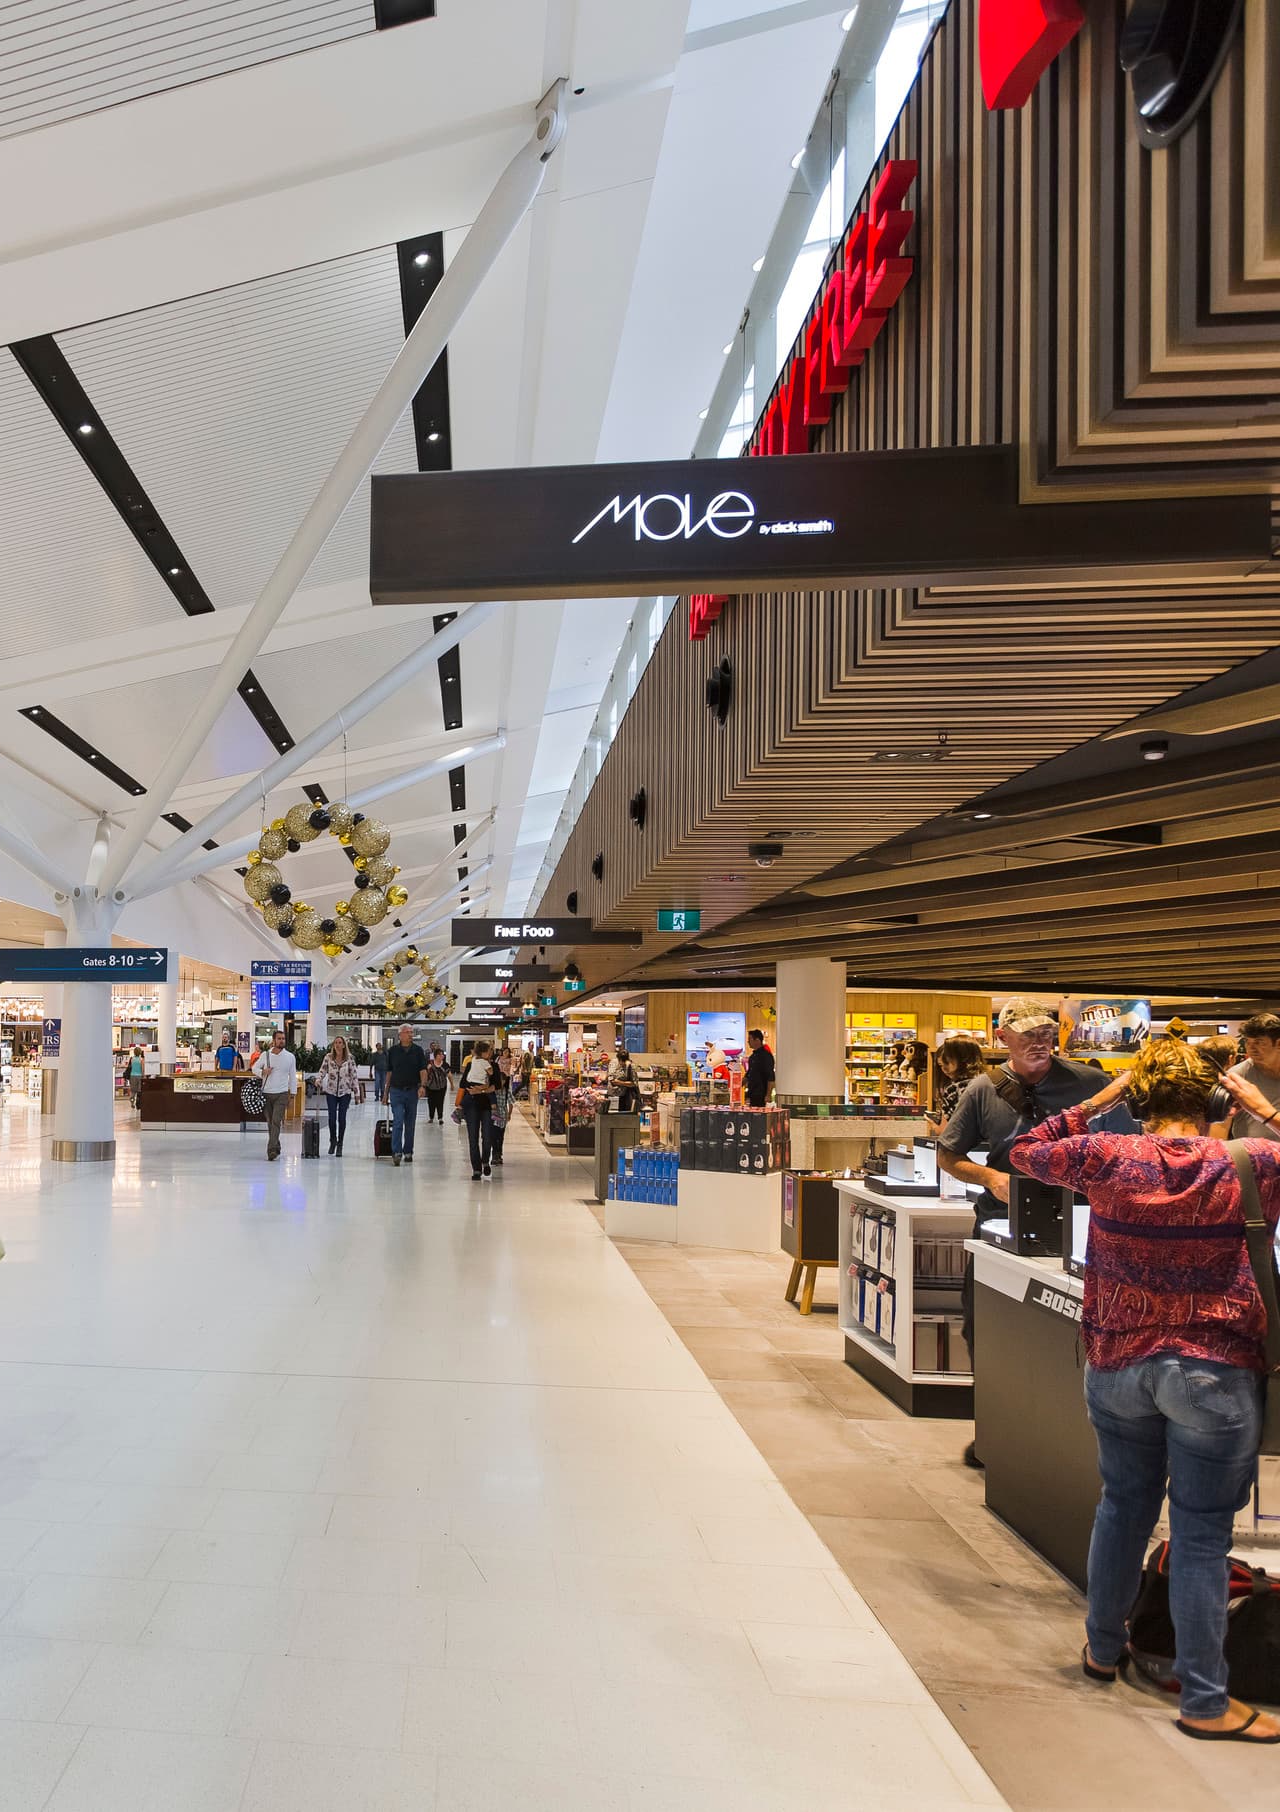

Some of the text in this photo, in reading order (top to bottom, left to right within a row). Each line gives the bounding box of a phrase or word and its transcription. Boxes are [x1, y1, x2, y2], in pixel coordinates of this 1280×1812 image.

[494, 925, 554, 937] FINE FOOD
[83, 955, 134, 966] Gates 8-10
[261, 965, 279, 973] TRS
